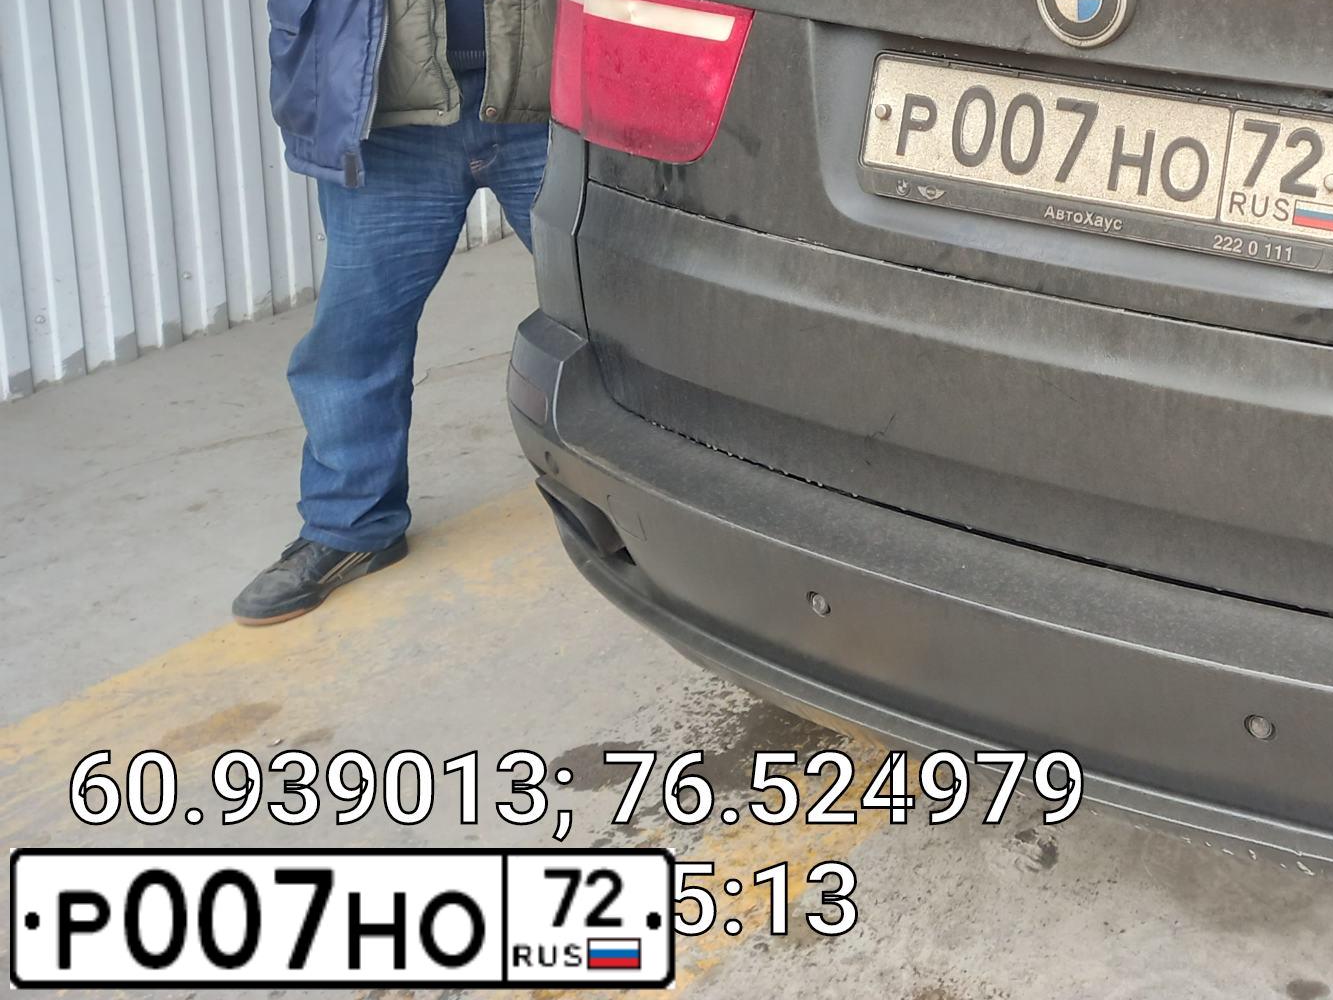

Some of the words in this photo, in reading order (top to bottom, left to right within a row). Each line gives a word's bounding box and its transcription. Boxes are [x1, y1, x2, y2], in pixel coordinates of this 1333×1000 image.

[1242, 118, 1325, 198] 72
[1043, 205, 1123, 232] АвтоХаус
[1228, 191, 1290, 222] RUS
[1213, 234, 1243, 254] 222
[1248, 240, 1258, 256] 0
[1265, 243, 1292, 262] 111
